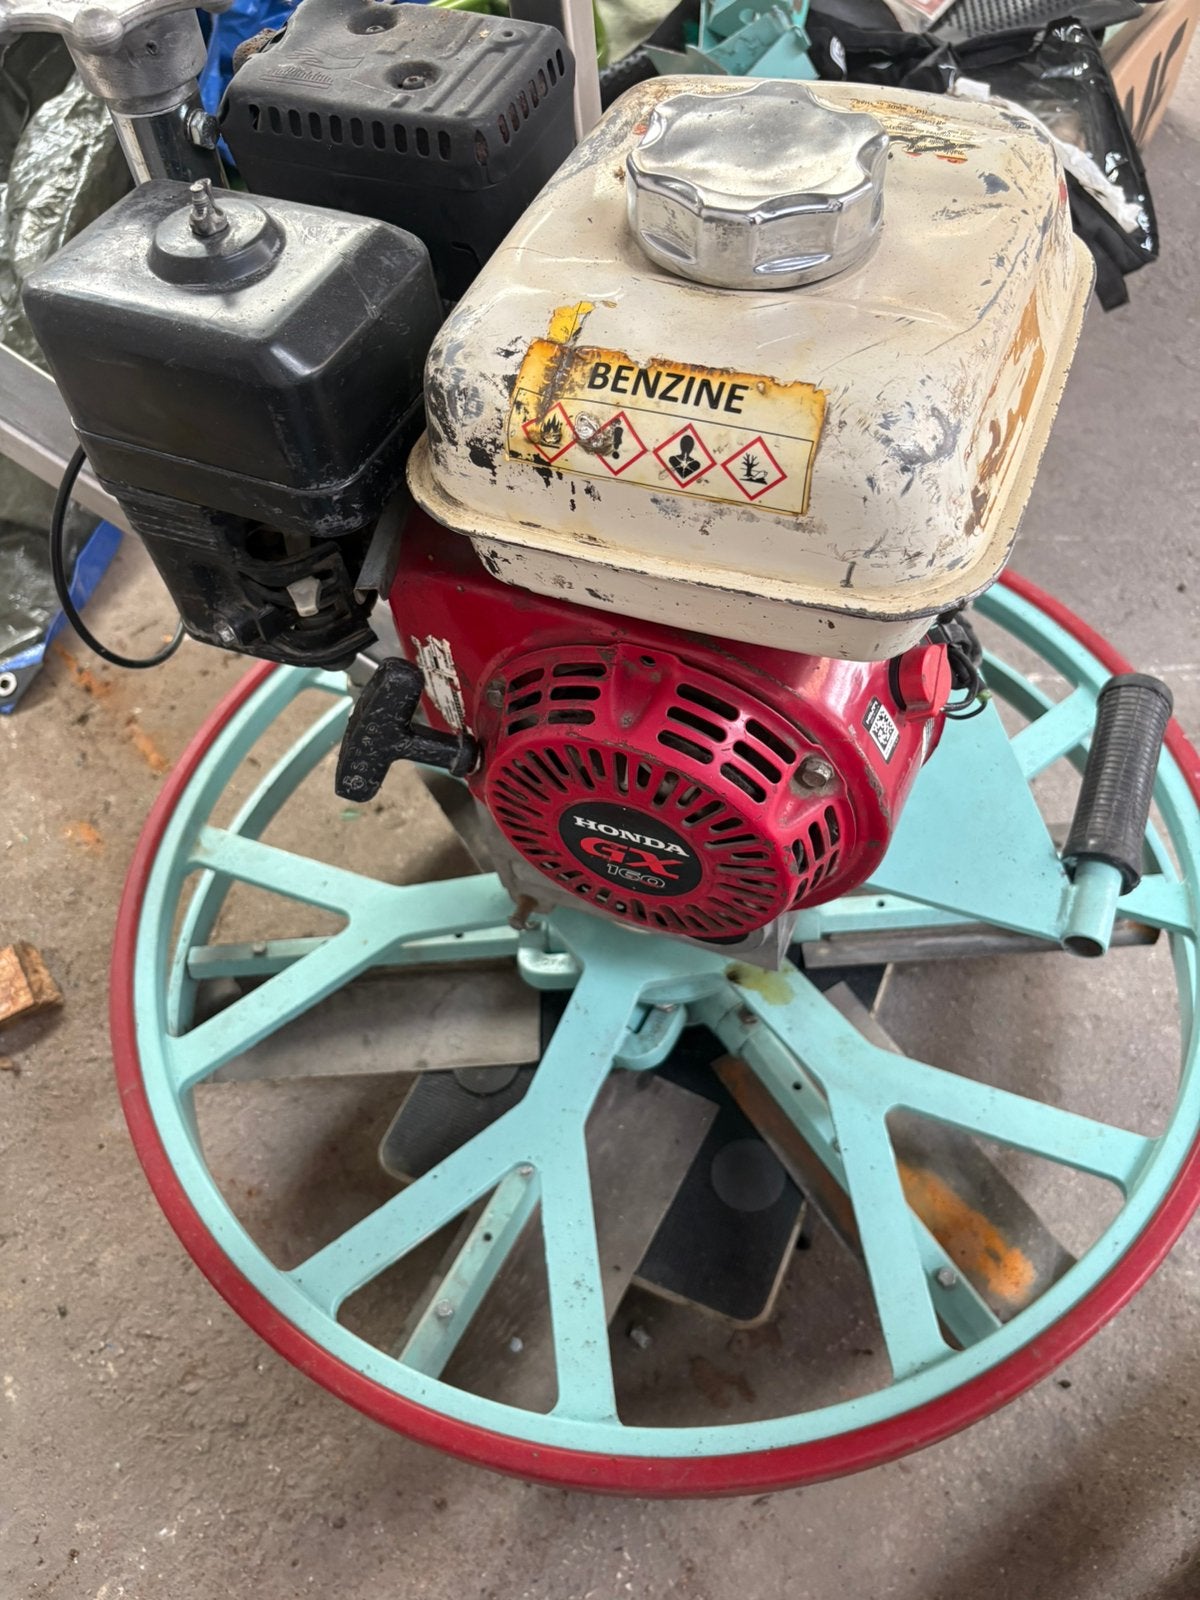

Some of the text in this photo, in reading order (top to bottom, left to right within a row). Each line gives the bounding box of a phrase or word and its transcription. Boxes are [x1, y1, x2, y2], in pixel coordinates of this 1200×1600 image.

[588, 362, 749, 414] BENZINE
[574, 816, 689, 857] HONDA
[580, 837, 683, 879] GX
[606, 864, 665, 889] 160
